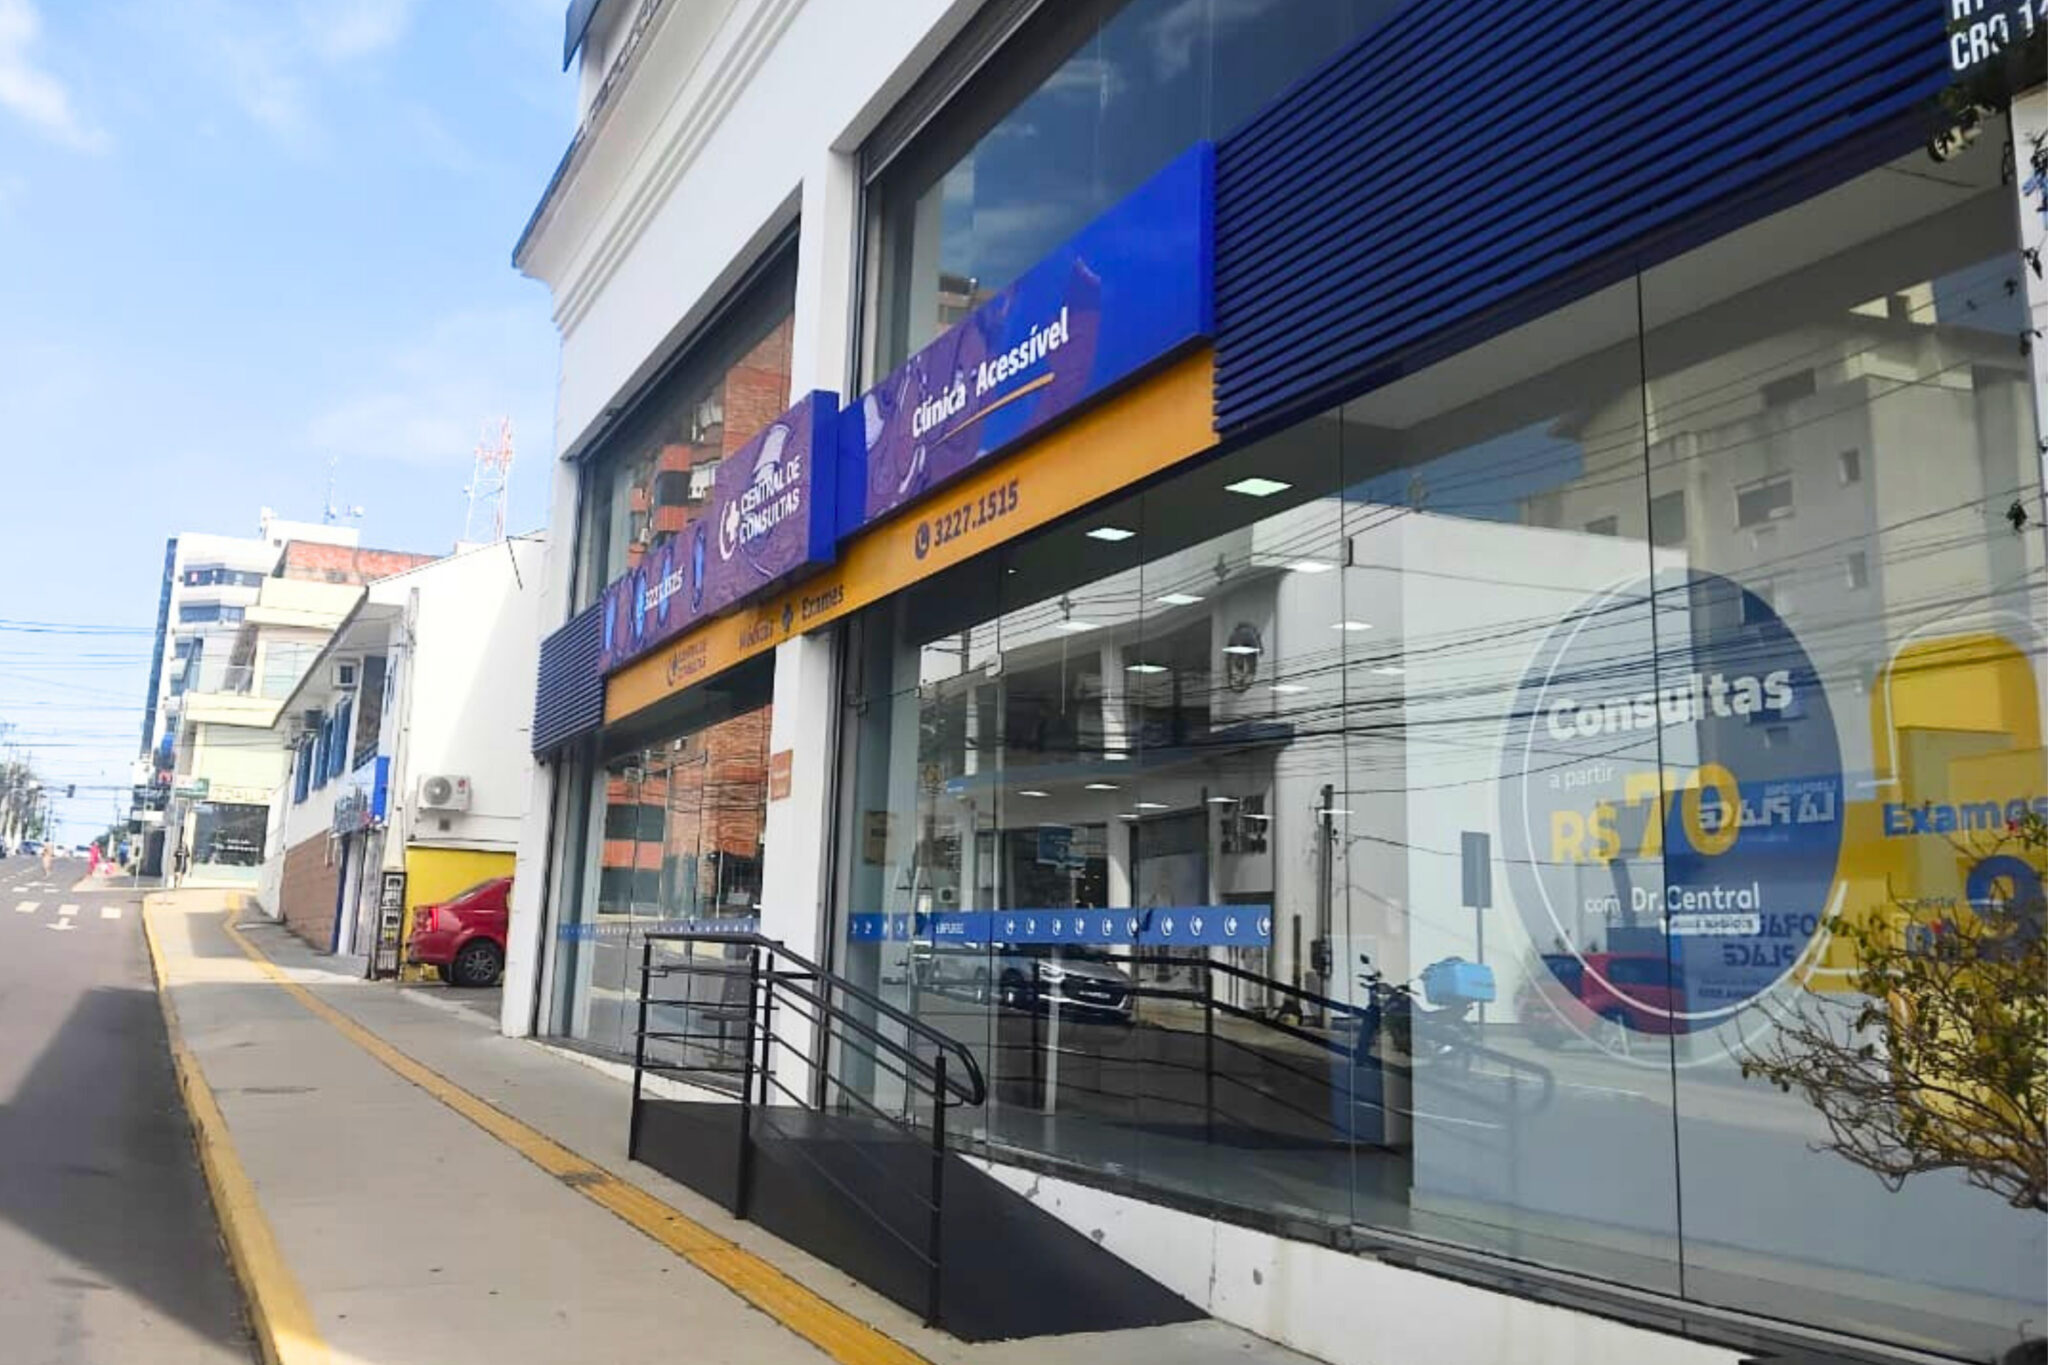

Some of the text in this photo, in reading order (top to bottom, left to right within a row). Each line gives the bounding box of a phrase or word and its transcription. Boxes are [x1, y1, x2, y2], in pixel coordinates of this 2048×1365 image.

[912, 305, 1069, 438] Clínica Acessível
[739, 487, 800, 544] CONSULTAS
[741, 466, 785, 515] CENTRAL
[934, 480, 1018, 547] 3227.1515
[803, 584, 844, 618] Exames
[1548, 669, 1794, 741] Consultas
[1550, 763, 1615, 794] a partir
[1551, 762, 1742, 871] R$ 70
[1584, 895, 1622, 914] com
